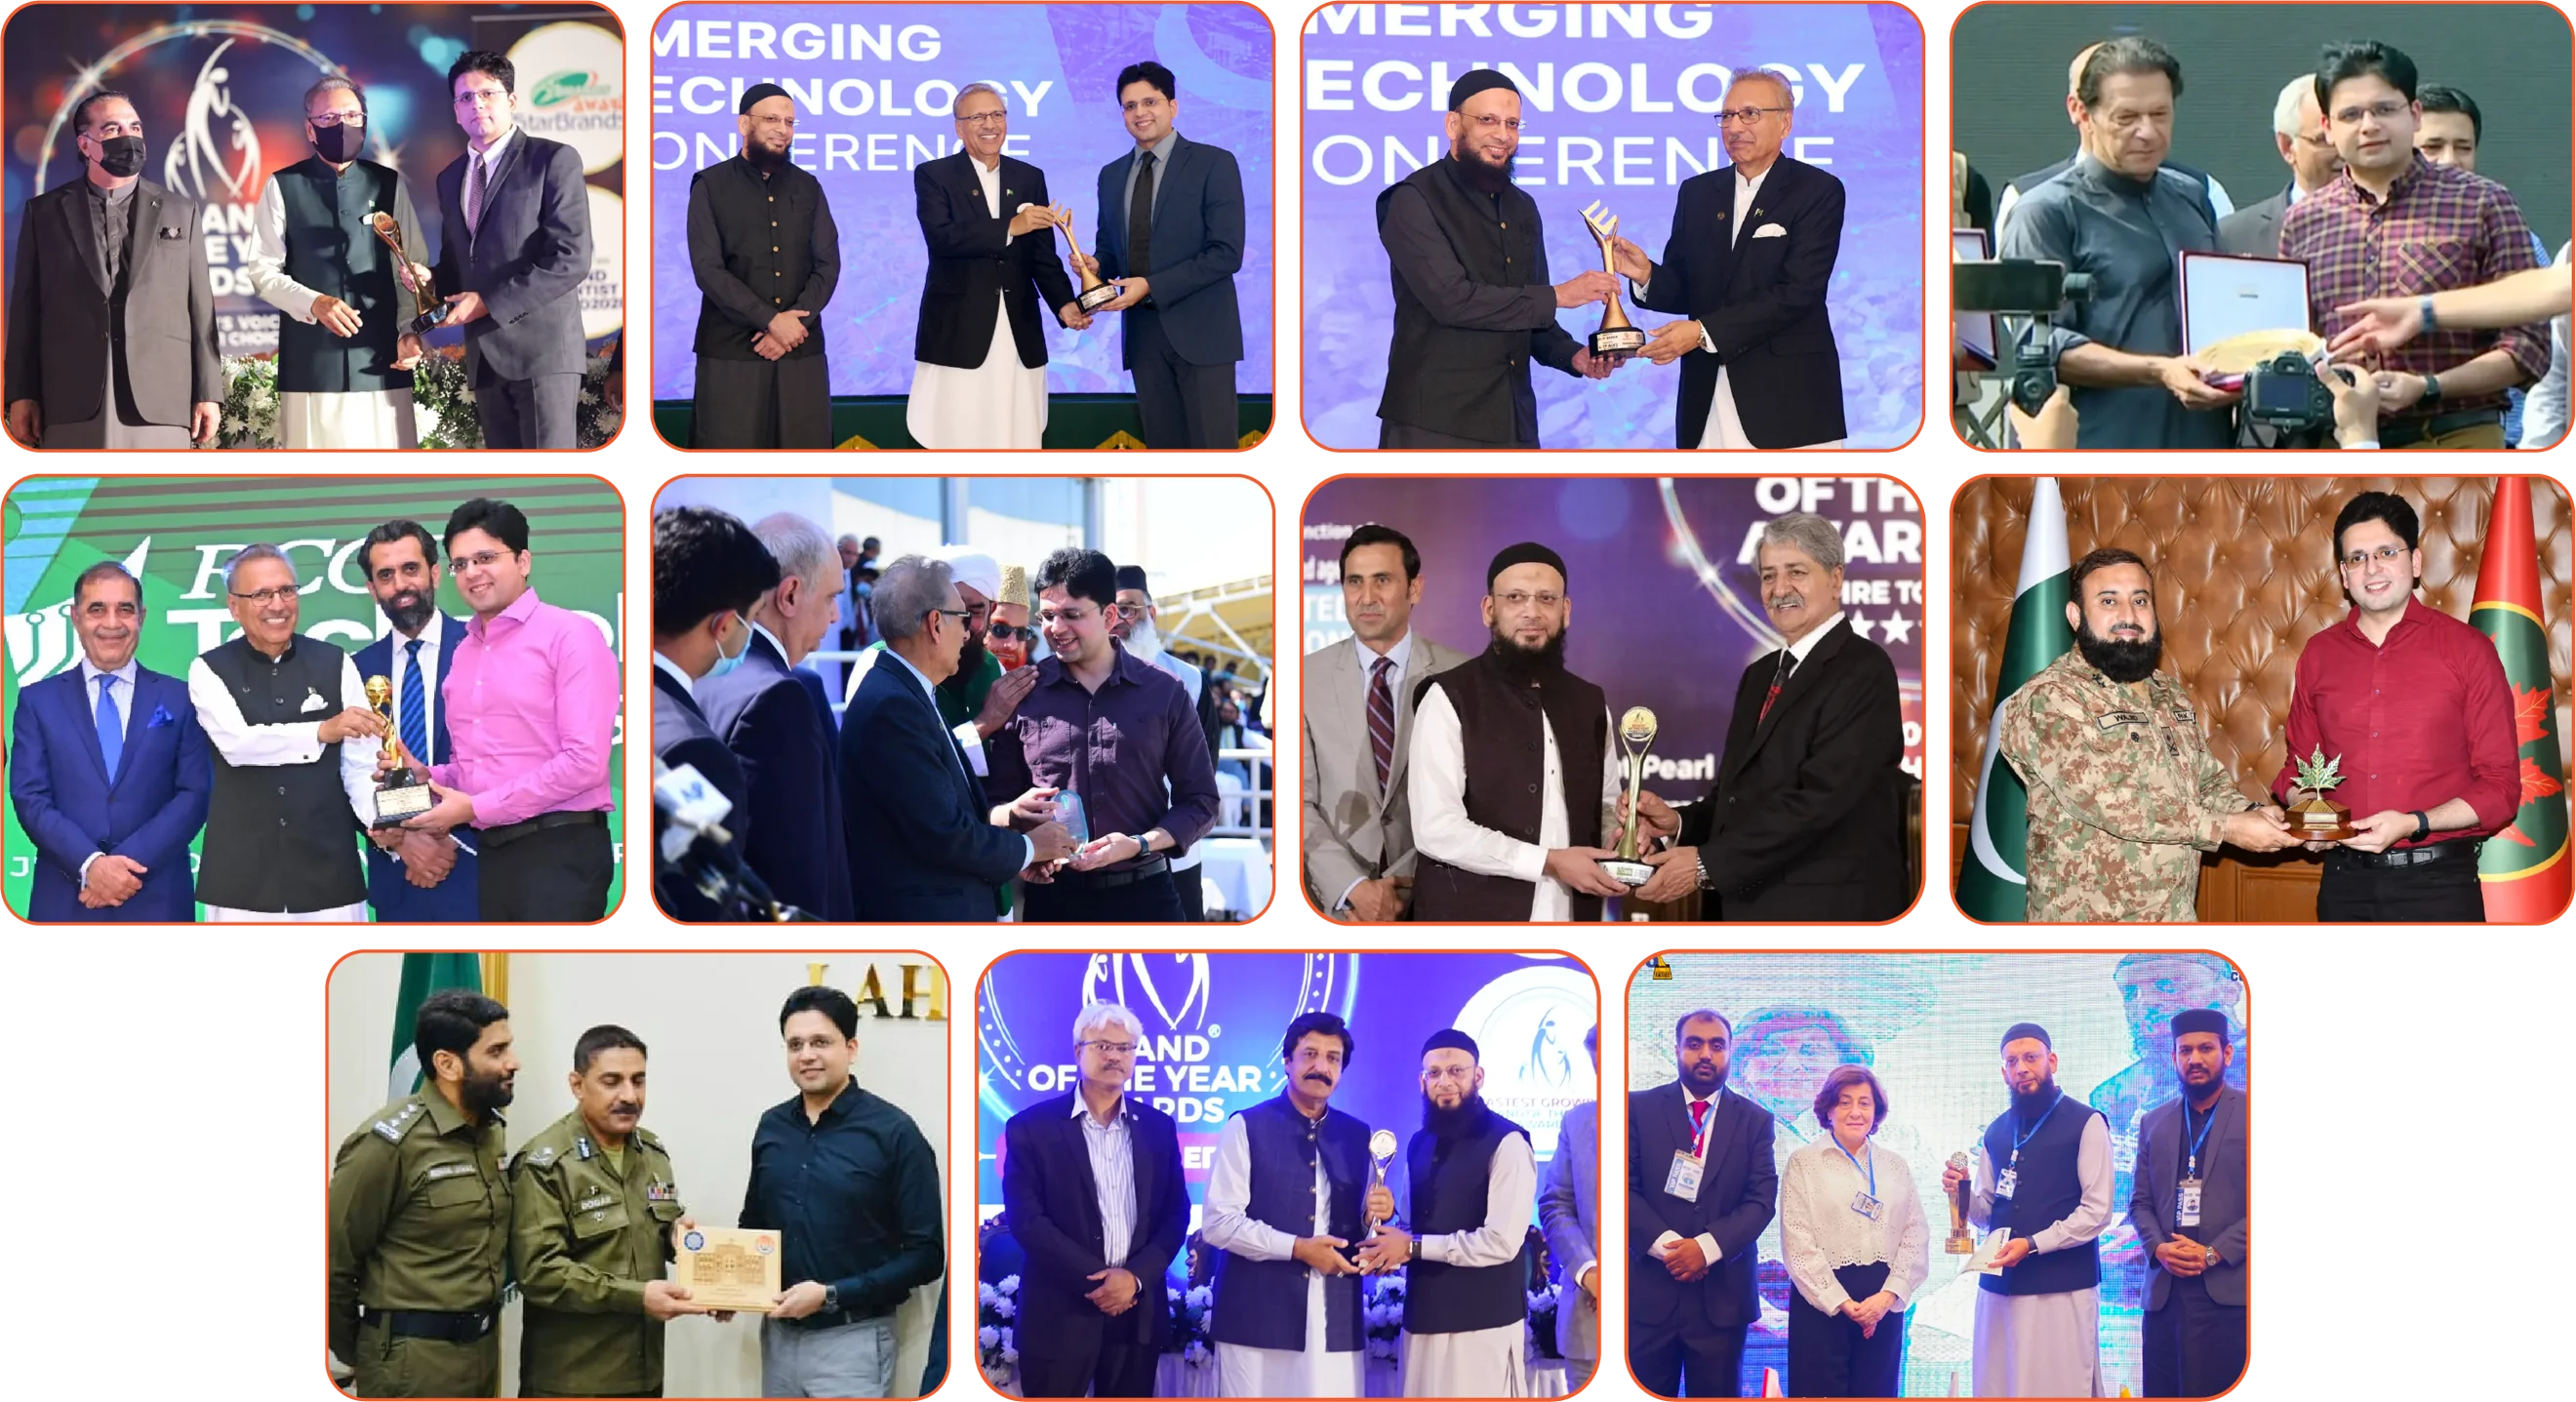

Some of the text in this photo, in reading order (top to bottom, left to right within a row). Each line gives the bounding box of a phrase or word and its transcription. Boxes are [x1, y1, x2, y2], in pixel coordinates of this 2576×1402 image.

[653, 20, 942, 61] MERGING
[1312, 135, 1834, 185] ONERENE
[1027, 1064, 1077, 1092] OF
[1164, 1064, 1262, 1093] YEAR
